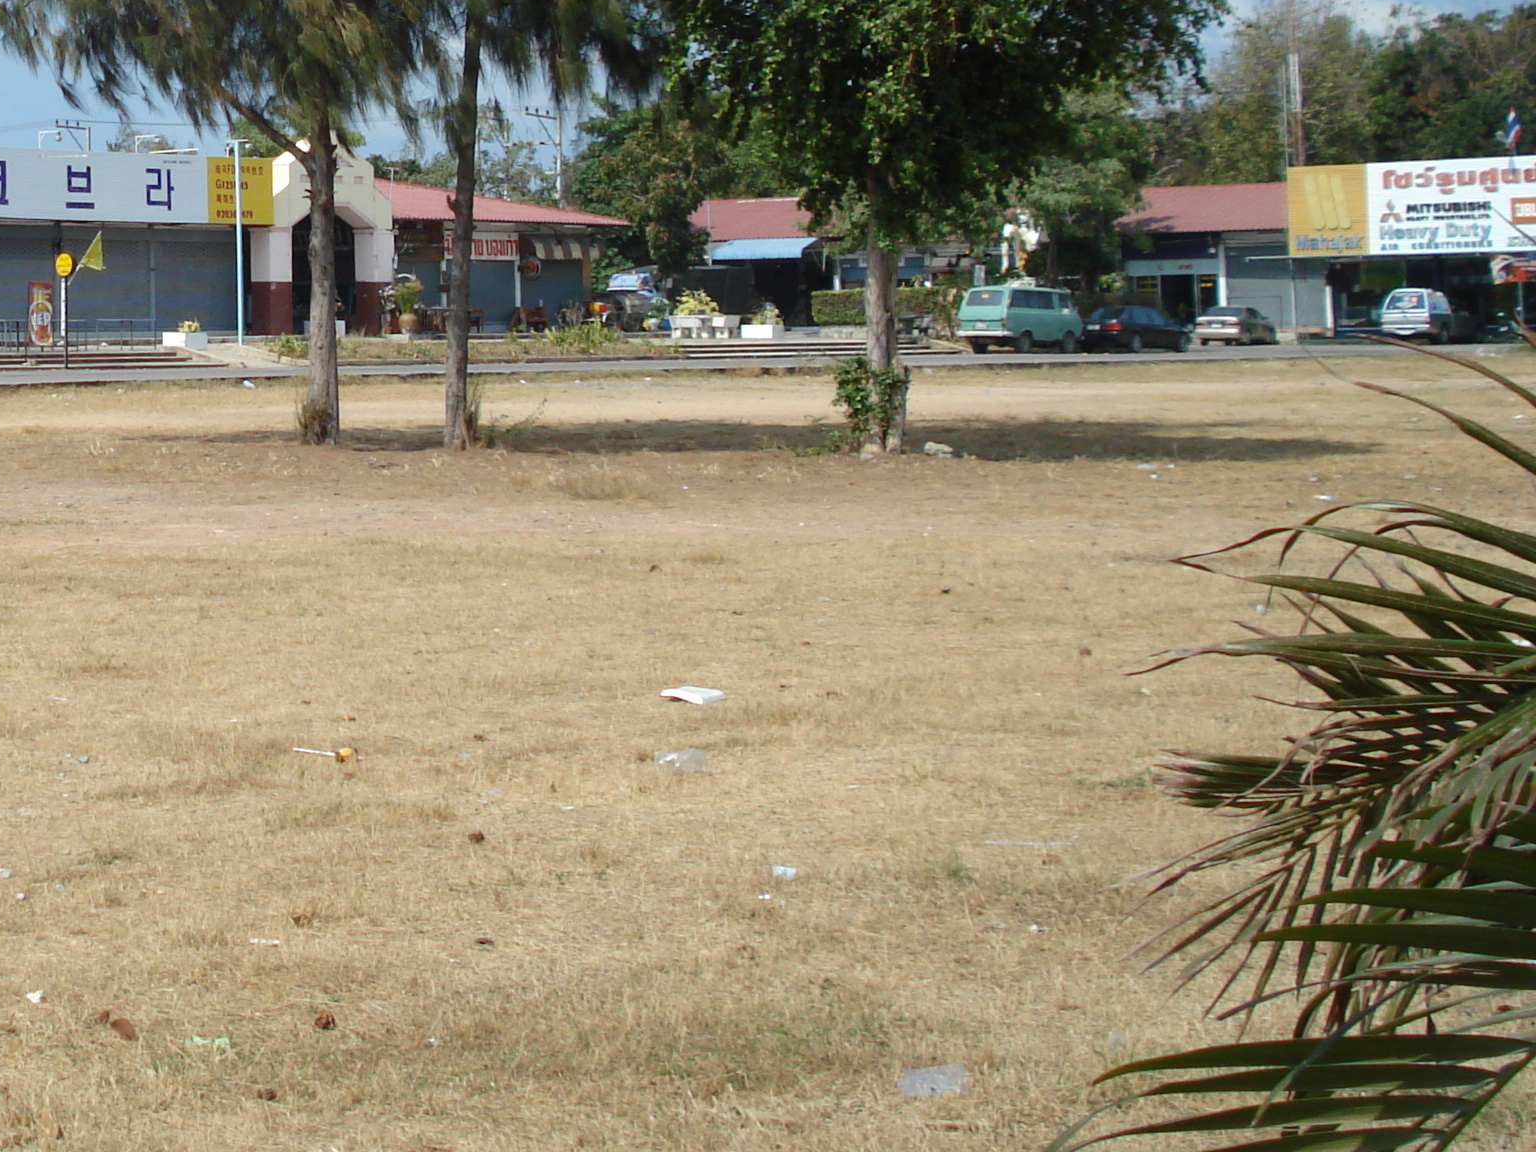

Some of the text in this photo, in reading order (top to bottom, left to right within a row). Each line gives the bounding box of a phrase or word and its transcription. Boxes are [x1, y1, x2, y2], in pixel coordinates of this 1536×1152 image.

[1406, 201, 1492, 215] MITSUBISHI
[1380, 223, 1440, 244] Heavy
[1446, 222, 1493, 244] Duty
[1295, 234, 1363, 254] Mahajak
